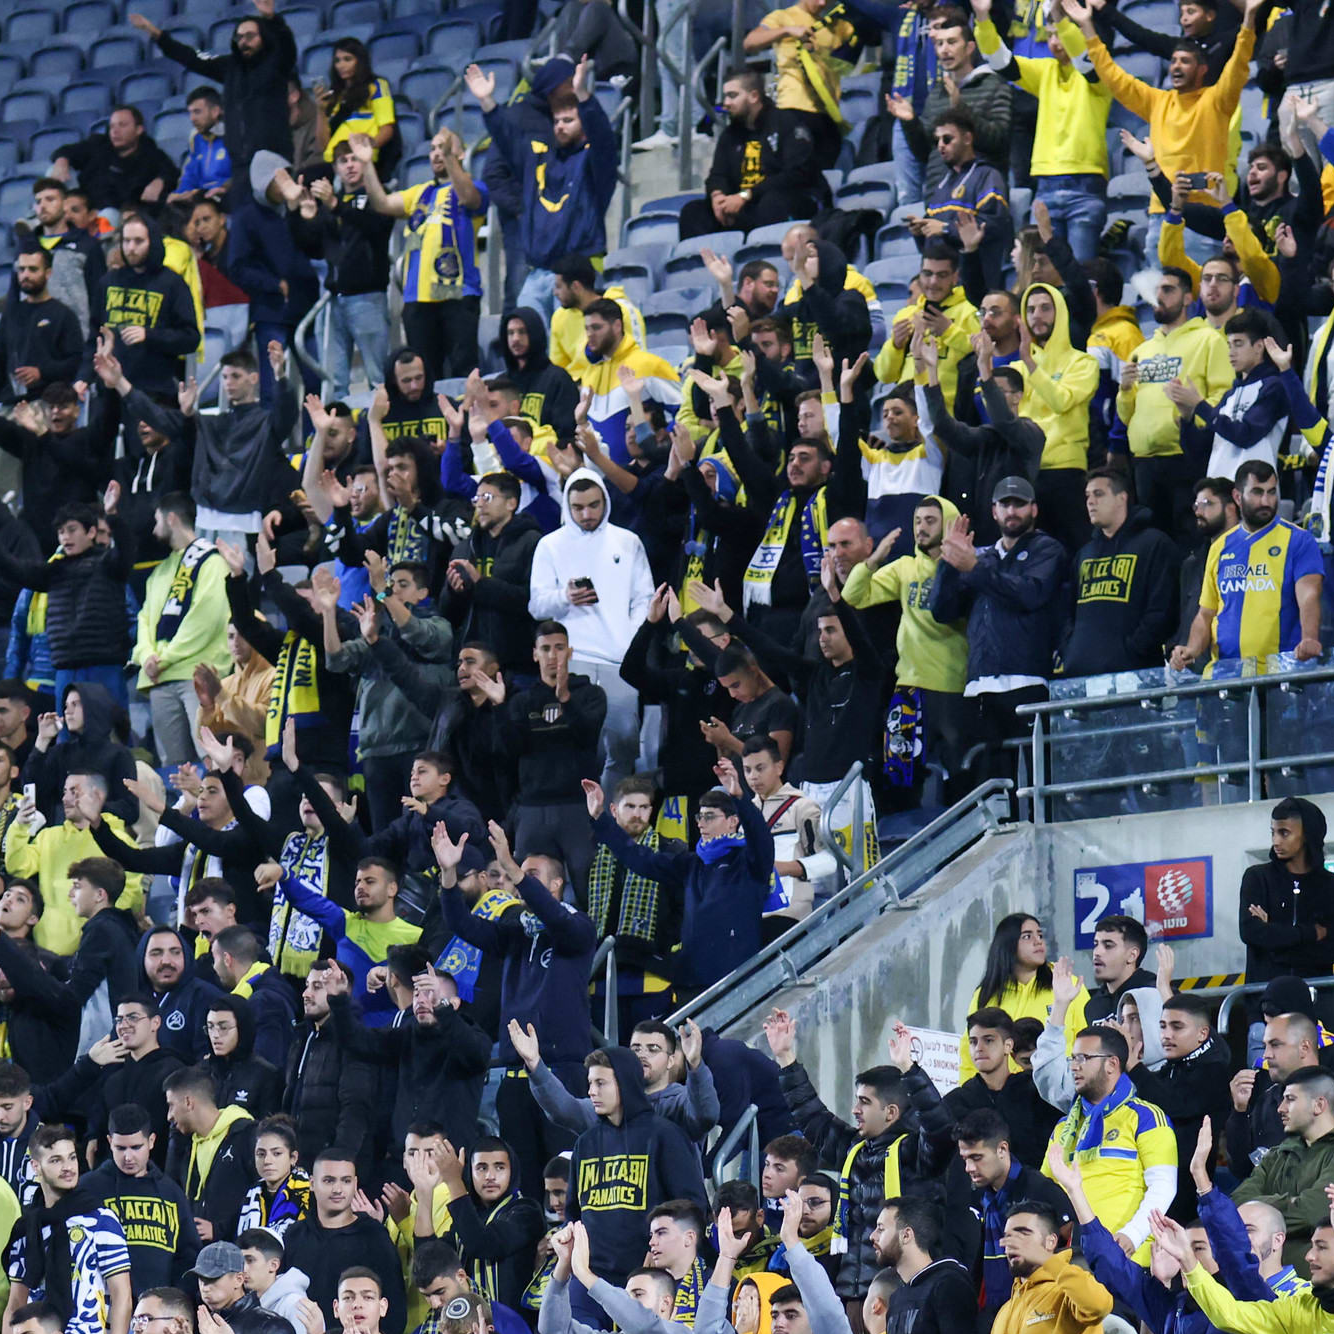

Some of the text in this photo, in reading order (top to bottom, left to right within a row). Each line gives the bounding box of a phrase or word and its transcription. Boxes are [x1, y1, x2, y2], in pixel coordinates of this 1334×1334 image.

[1224, 564, 1269, 578] ISRAEL
[1220, 578, 1276, 594] CANADA
[588, 1186, 635, 1206] FANATICS
